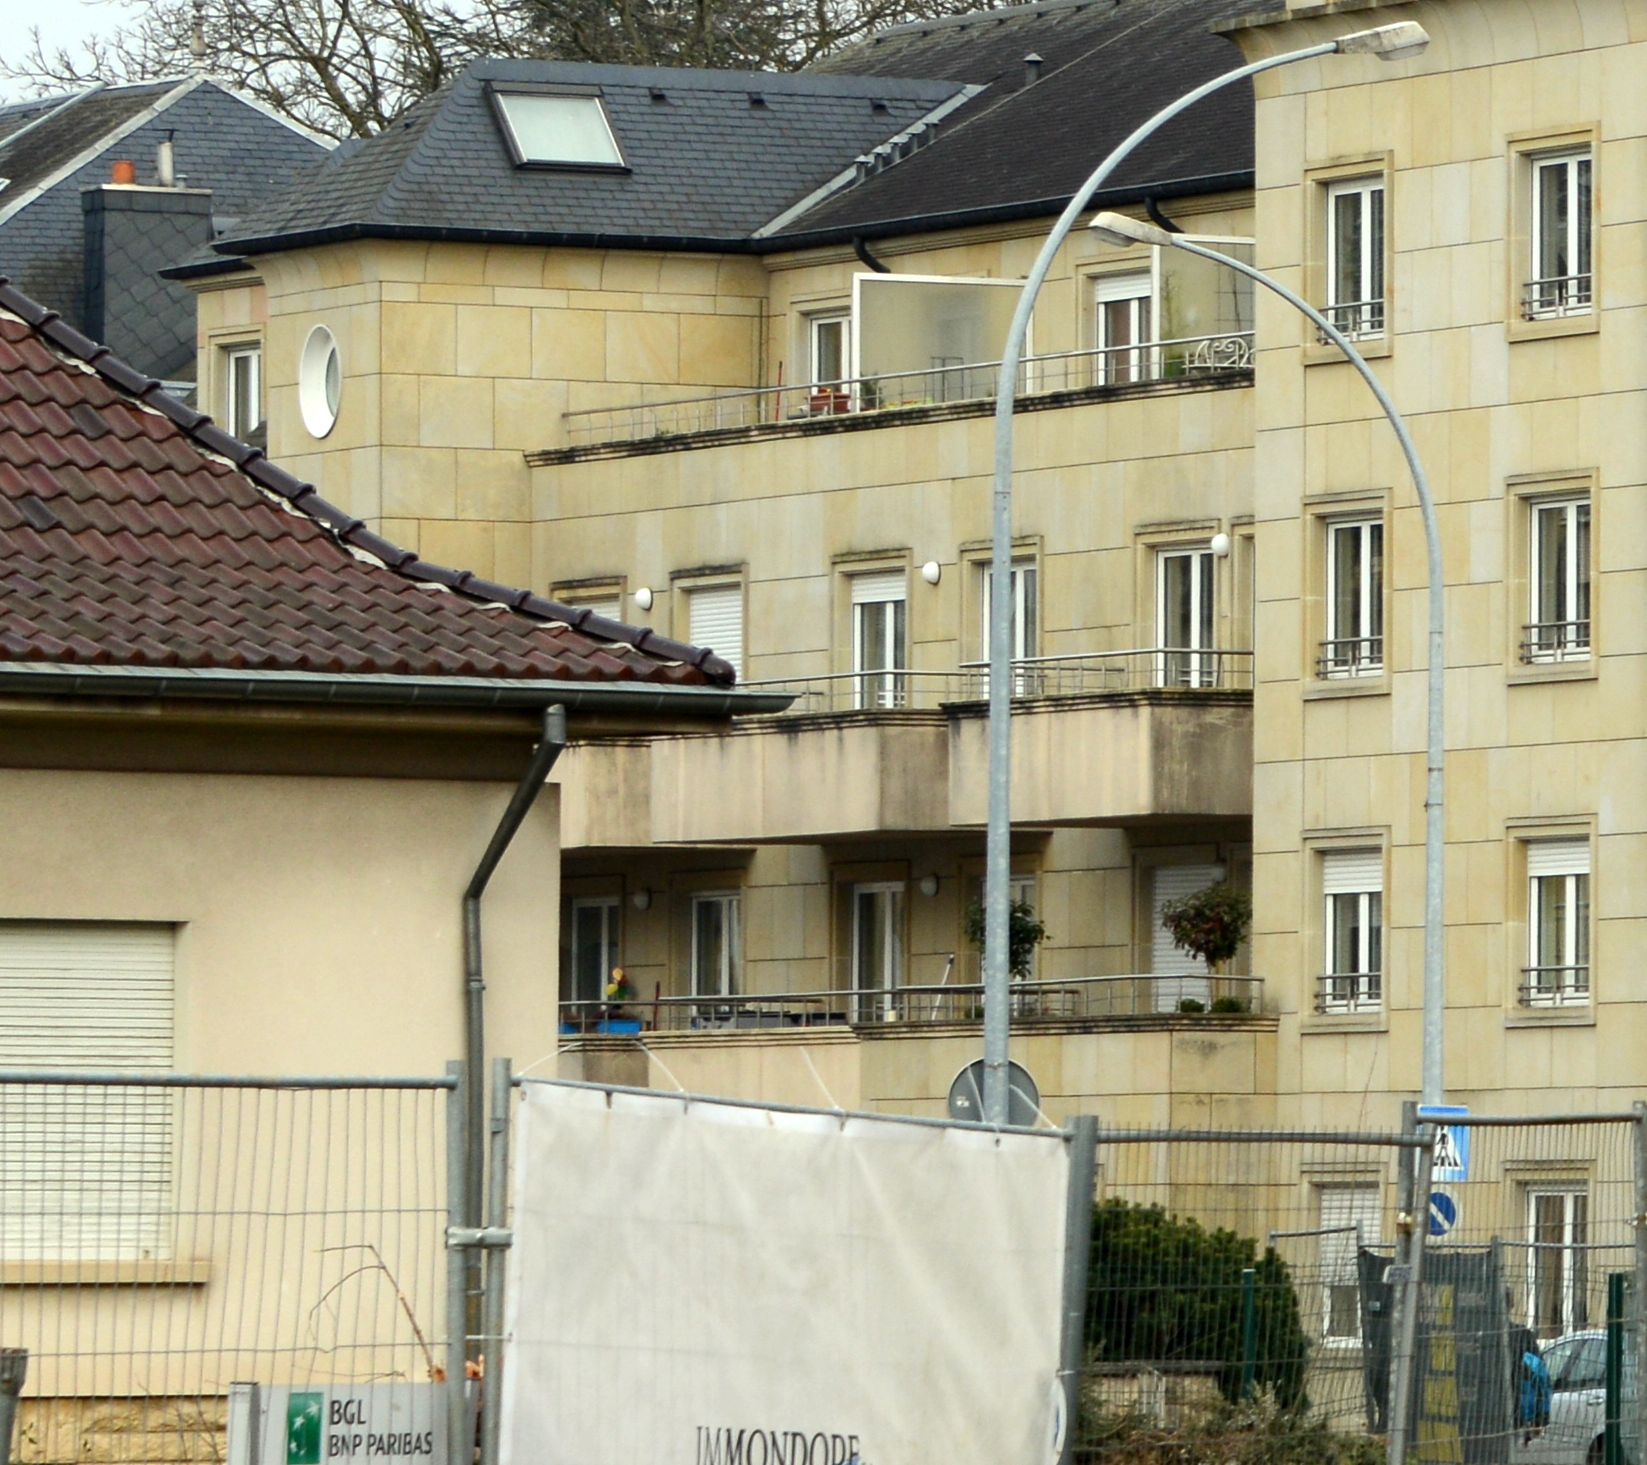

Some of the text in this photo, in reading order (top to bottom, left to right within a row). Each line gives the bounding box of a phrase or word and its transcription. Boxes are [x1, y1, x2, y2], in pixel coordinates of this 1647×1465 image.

[329, 1399, 367, 1426] BGL
[328, 1431, 433, 1458] BNP PARIBAS
